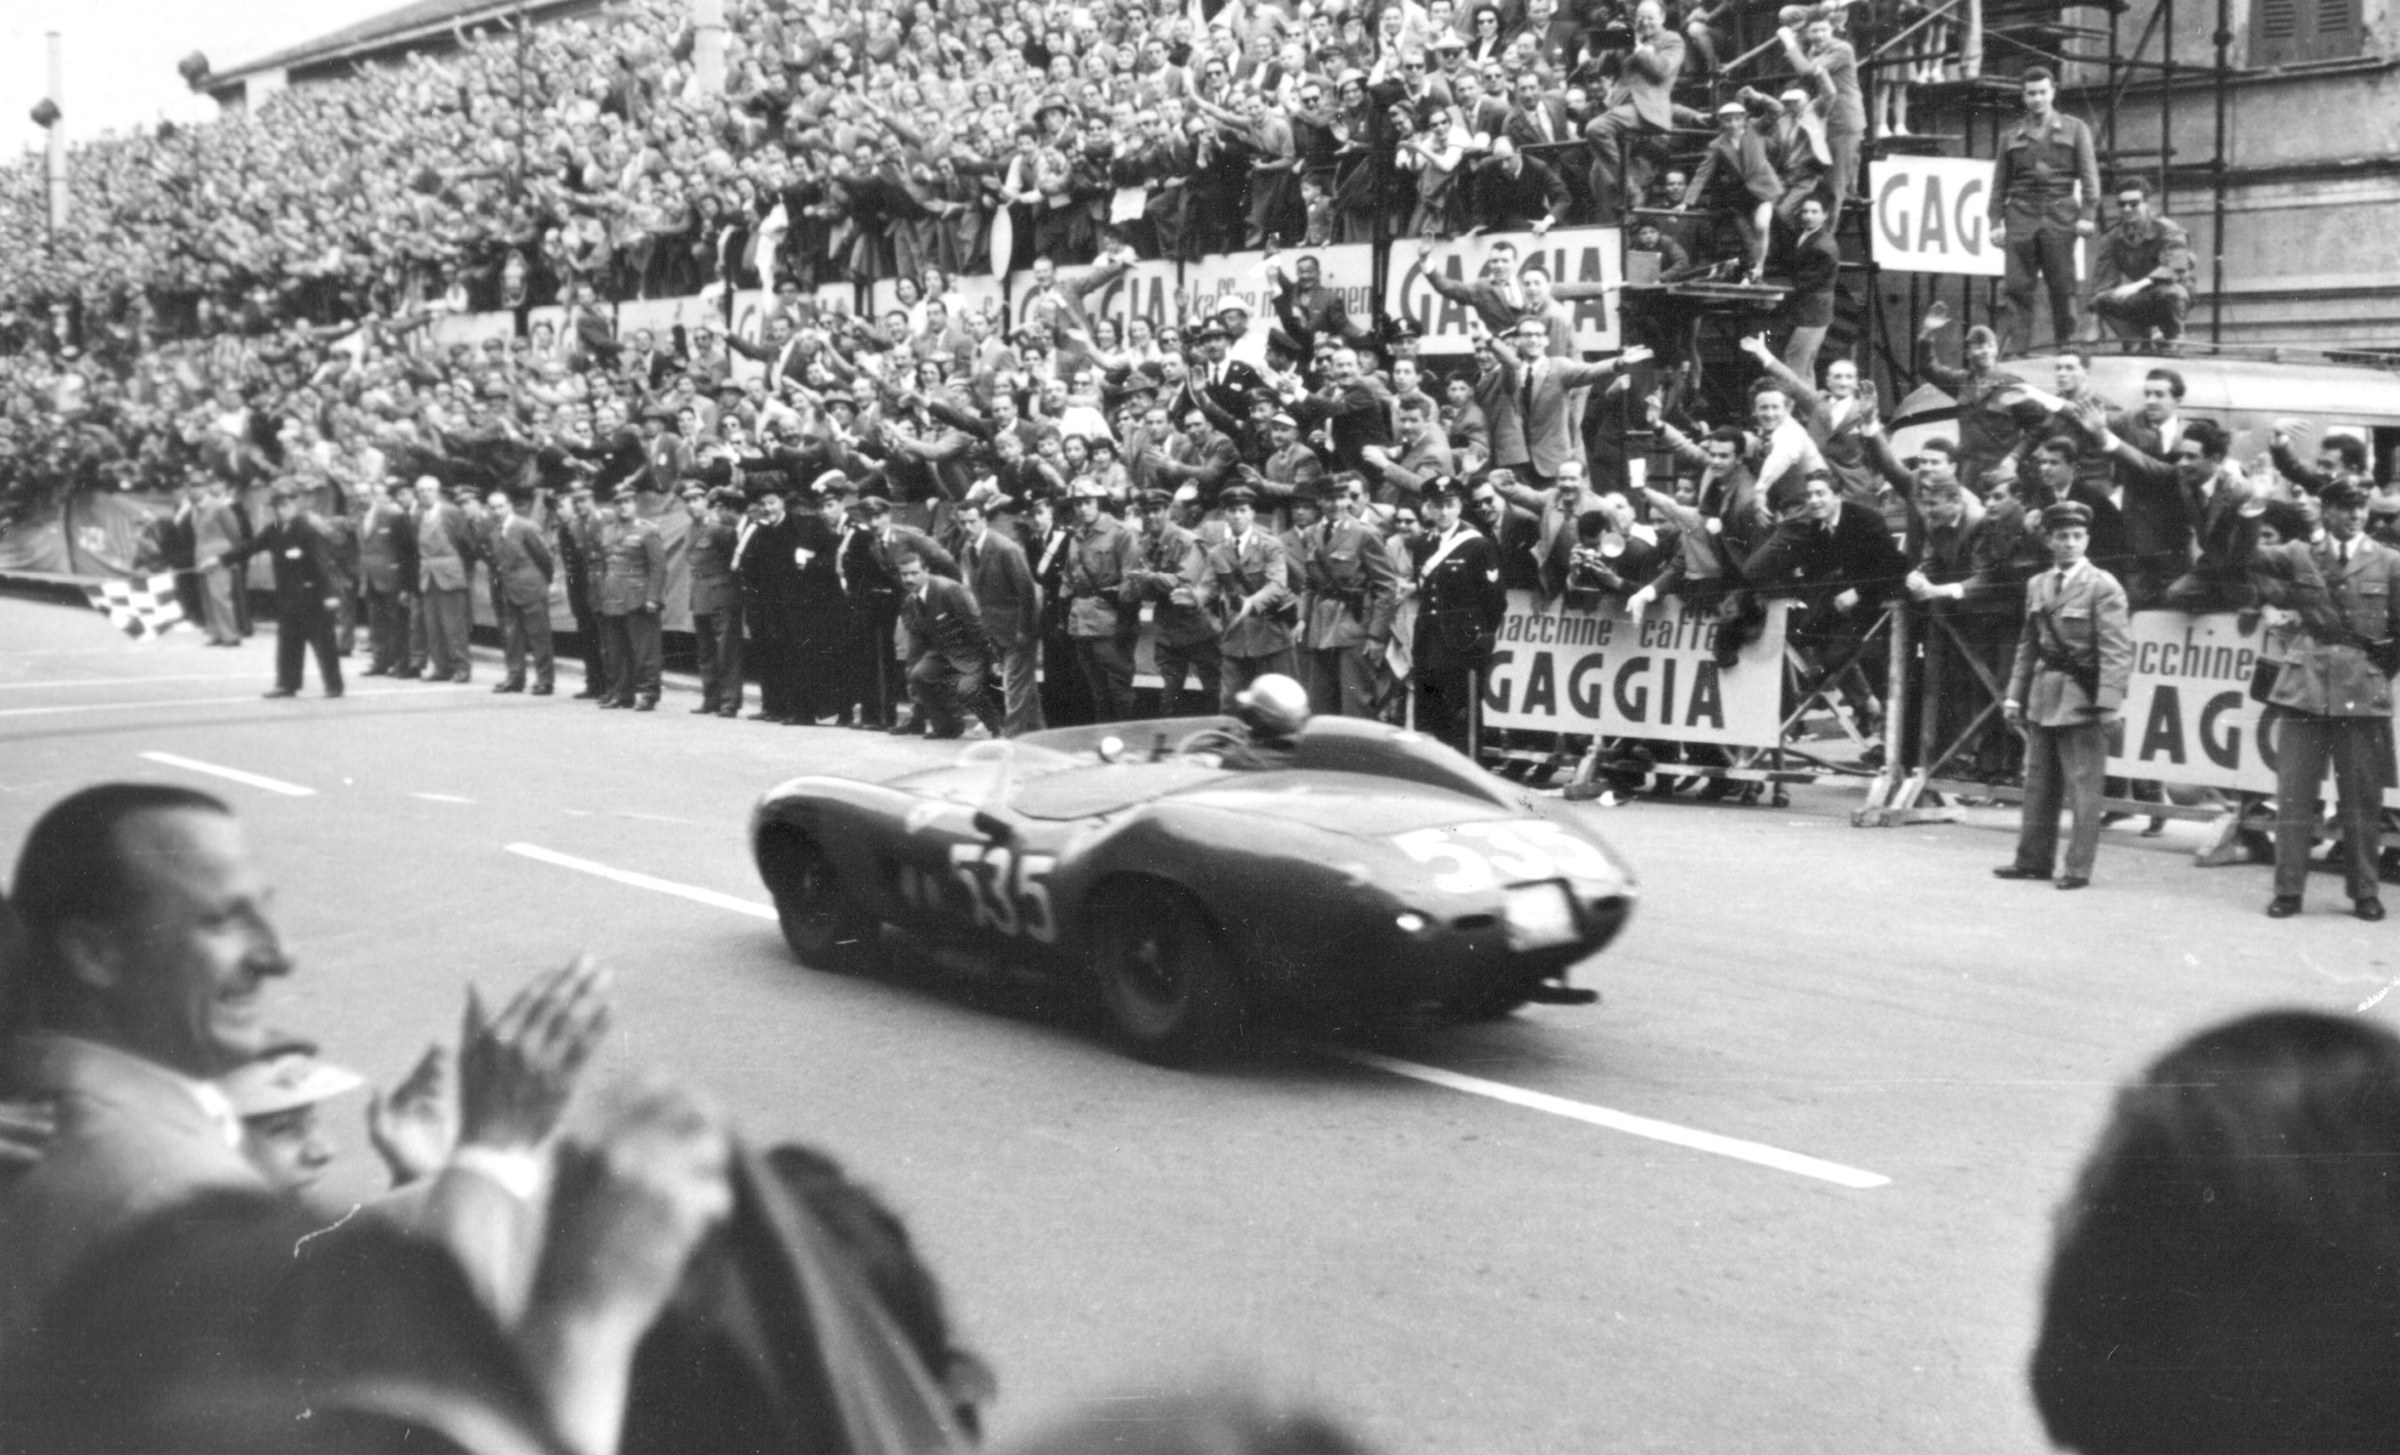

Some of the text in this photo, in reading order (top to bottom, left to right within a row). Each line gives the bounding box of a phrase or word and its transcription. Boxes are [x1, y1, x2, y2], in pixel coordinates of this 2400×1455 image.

[1192, 277, 1257, 321] kaffe
[1400, 247, 1608, 336] GAA
[1484, 650, 1725, 729] GAGGIA
[950, 843, 1056, 944] 535
[1391, 819, 1609, 895] 535
